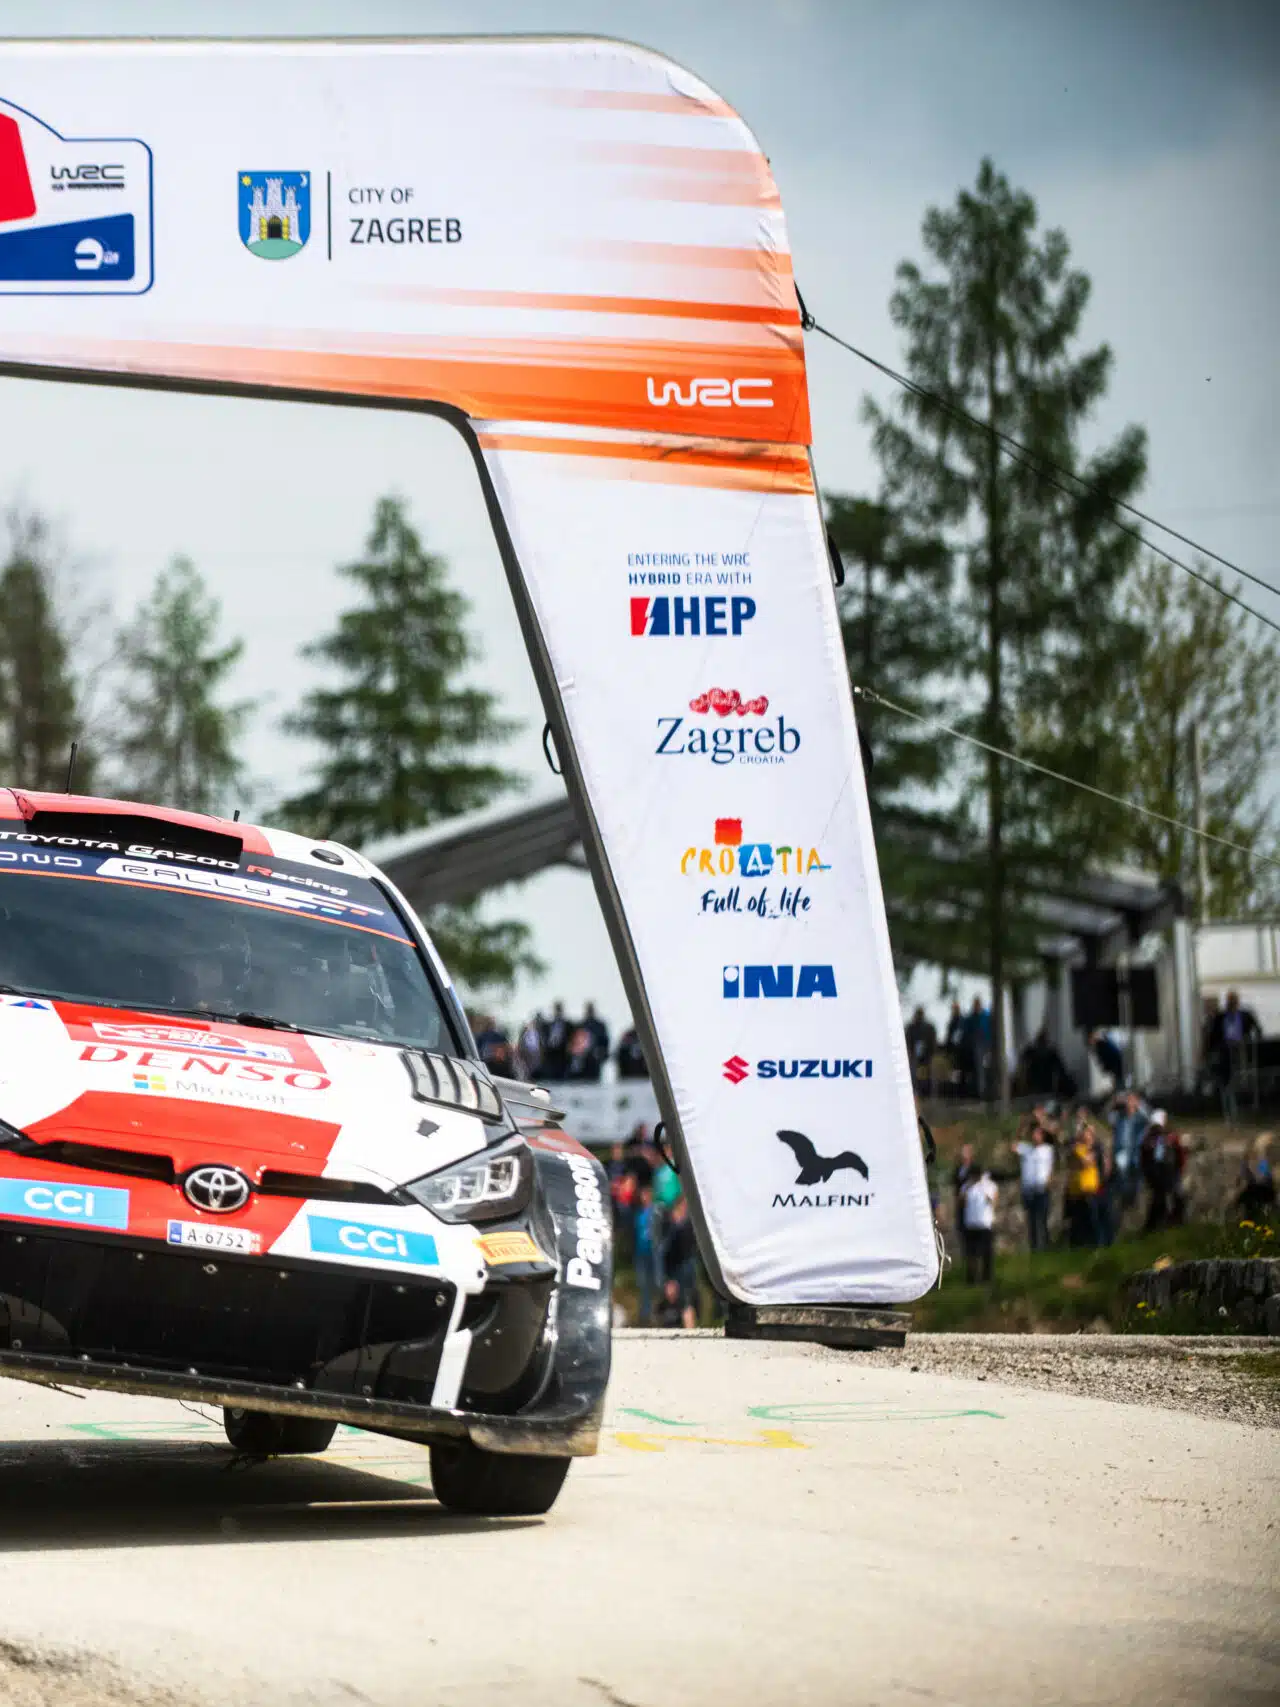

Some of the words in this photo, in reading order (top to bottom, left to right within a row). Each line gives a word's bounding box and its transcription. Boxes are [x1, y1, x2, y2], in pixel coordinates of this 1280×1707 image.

[51, 165, 125, 180] WRC
[349, 187, 384, 204] CITY
[391, 187, 414, 204] OF
[349, 217, 462, 245] ZAGREB
[646, 377, 774, 408] WRC
[628, 552, 690, 566] ENTERING
[693, 552, 718, 566] THE
[720, 552, 750, 566] WRC
[628, 572, 681, 585] HYBRID
[686, 572, 713, 585] ERA
[716, 572, 752, 585] WITH
[674, 596, 756, 636] HEP
[655, 716, 801, 765] Zagreb
[739, 755, 785, 765] CROATIA
[125, 844, 240, 869] GAZOO
[246, 864, 348, 896] Racing
[680, 845, 832, 877] CROATIA
[121, 864, 270, 896] RALLY
[701, 886, 742, 914] Full
[747, 888, 768, 917] of
[780, 886, 811, 917] life
[78, 1046, 331, 1090] DENSO
[756, 1059, 872, 1079] SUZUKI
[24, 1187, 94, 1217] CCI
[772, 1194, 869, 1208] MALFINI
[556, 1152, 603, 1290] Panasoni
[187, 1229, 244, 1248] A-6752
[339, 1226, 407, 1257] CCI
